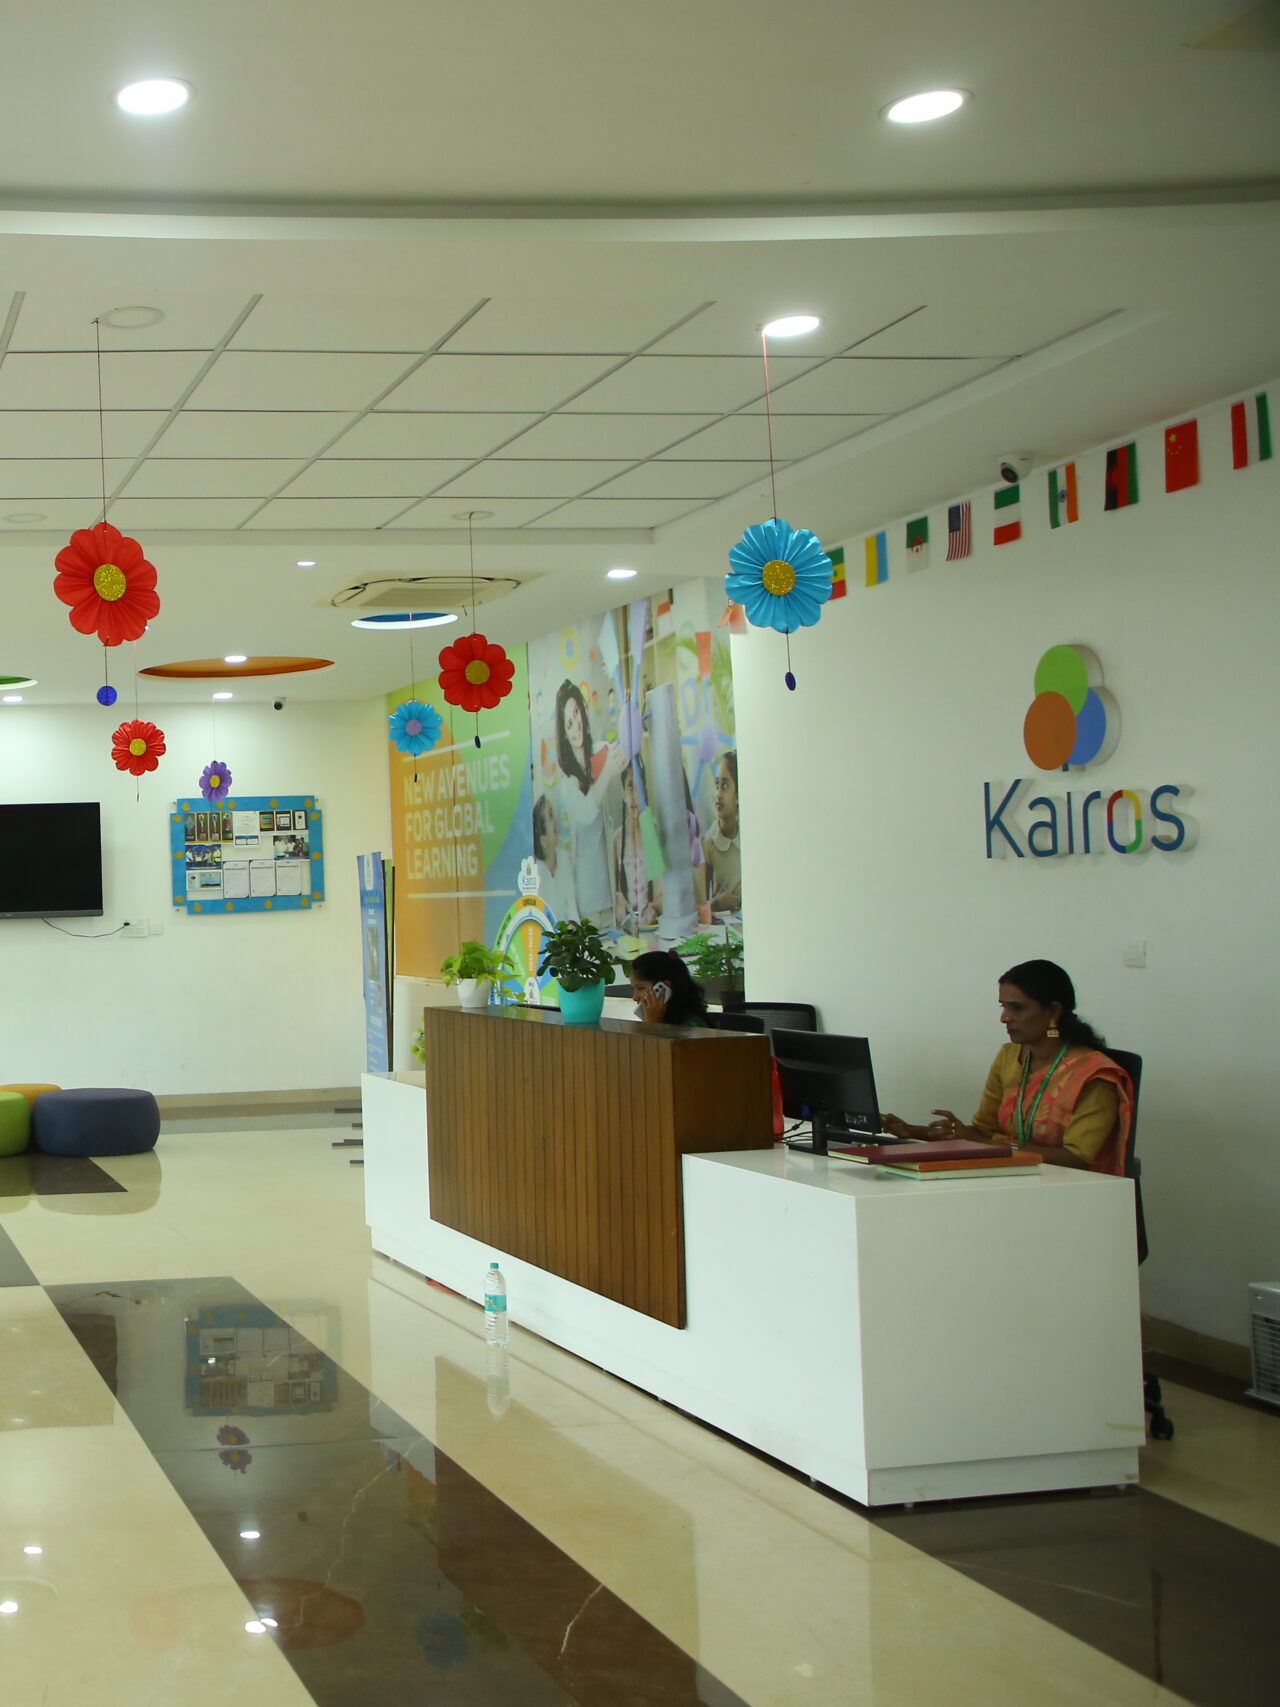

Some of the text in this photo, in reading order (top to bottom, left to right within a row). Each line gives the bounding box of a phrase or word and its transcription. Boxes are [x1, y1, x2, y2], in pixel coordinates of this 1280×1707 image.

[404, 753, 511, 807] NEW AVENUES
[405, 800, 496, 843] FOR GLOBAL
[984, 778, 1186, 859] Kairos
[406, 842, 478, 879] LEARNING
